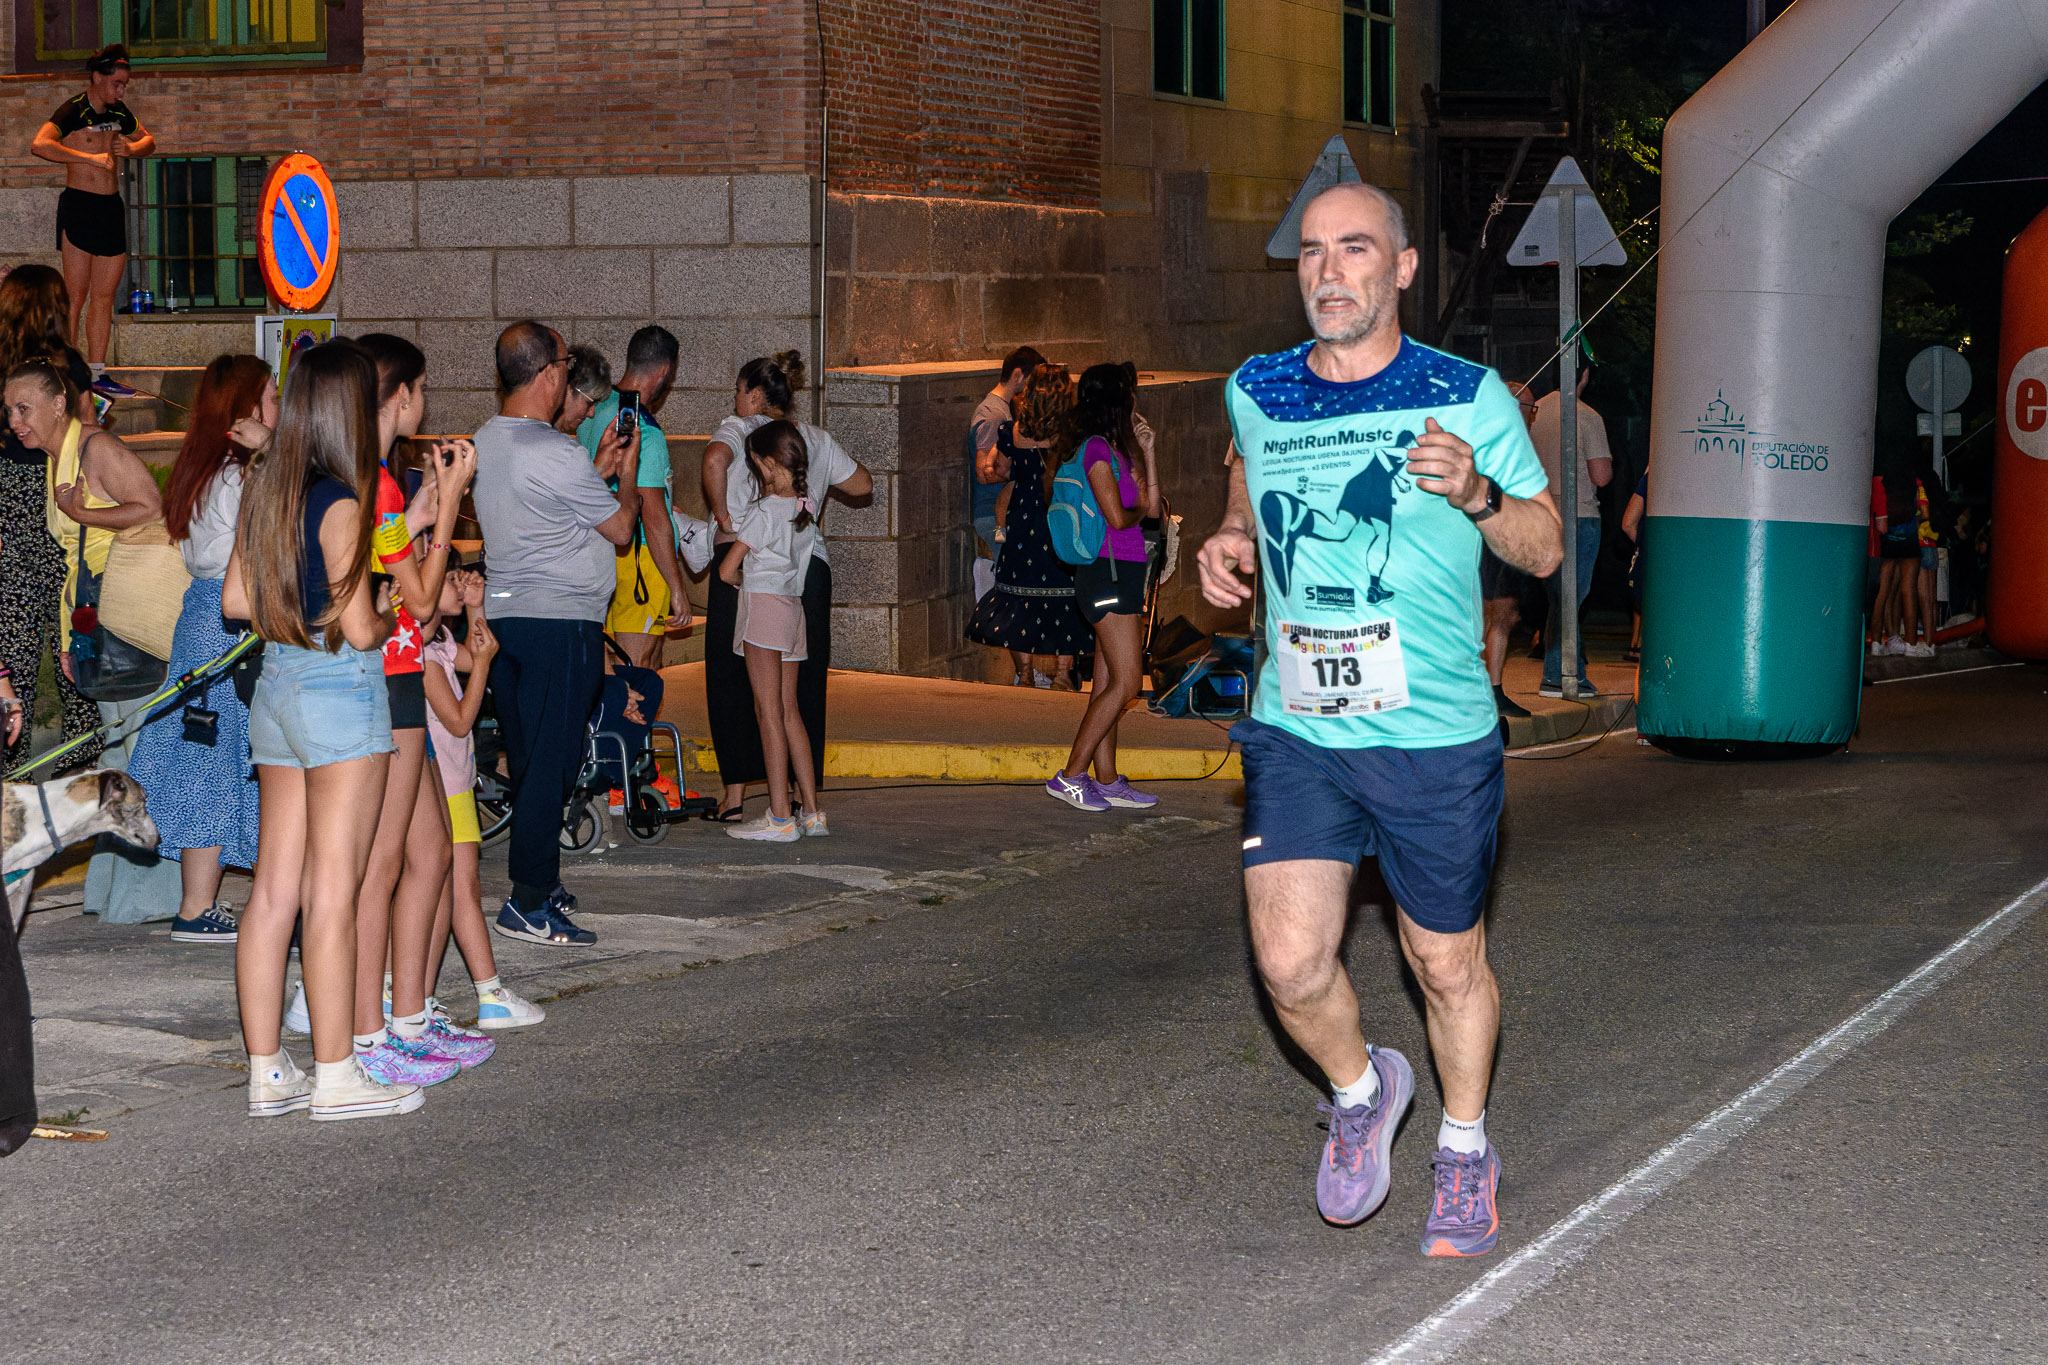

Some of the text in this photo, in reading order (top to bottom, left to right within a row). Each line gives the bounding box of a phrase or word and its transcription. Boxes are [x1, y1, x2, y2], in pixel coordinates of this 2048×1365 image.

[2015, 378, 2047, 432] e
[1264, 429, 1393, 454] NightRunMusic
[1817, 445, 1830, 455] DE
[1283, 454, 1316, 464] NOCTURNA
[1321, 460, 1351, 470] EVENTOS
[1305, 586, 1315, 600] S
[1290, 624, 1312, 637] LEGUA
[1313, 628, 1359, 640] NOCTURNA
[1360, 622, 1391, 637] UGENA
[1312, 657, 1362, 687] 173
